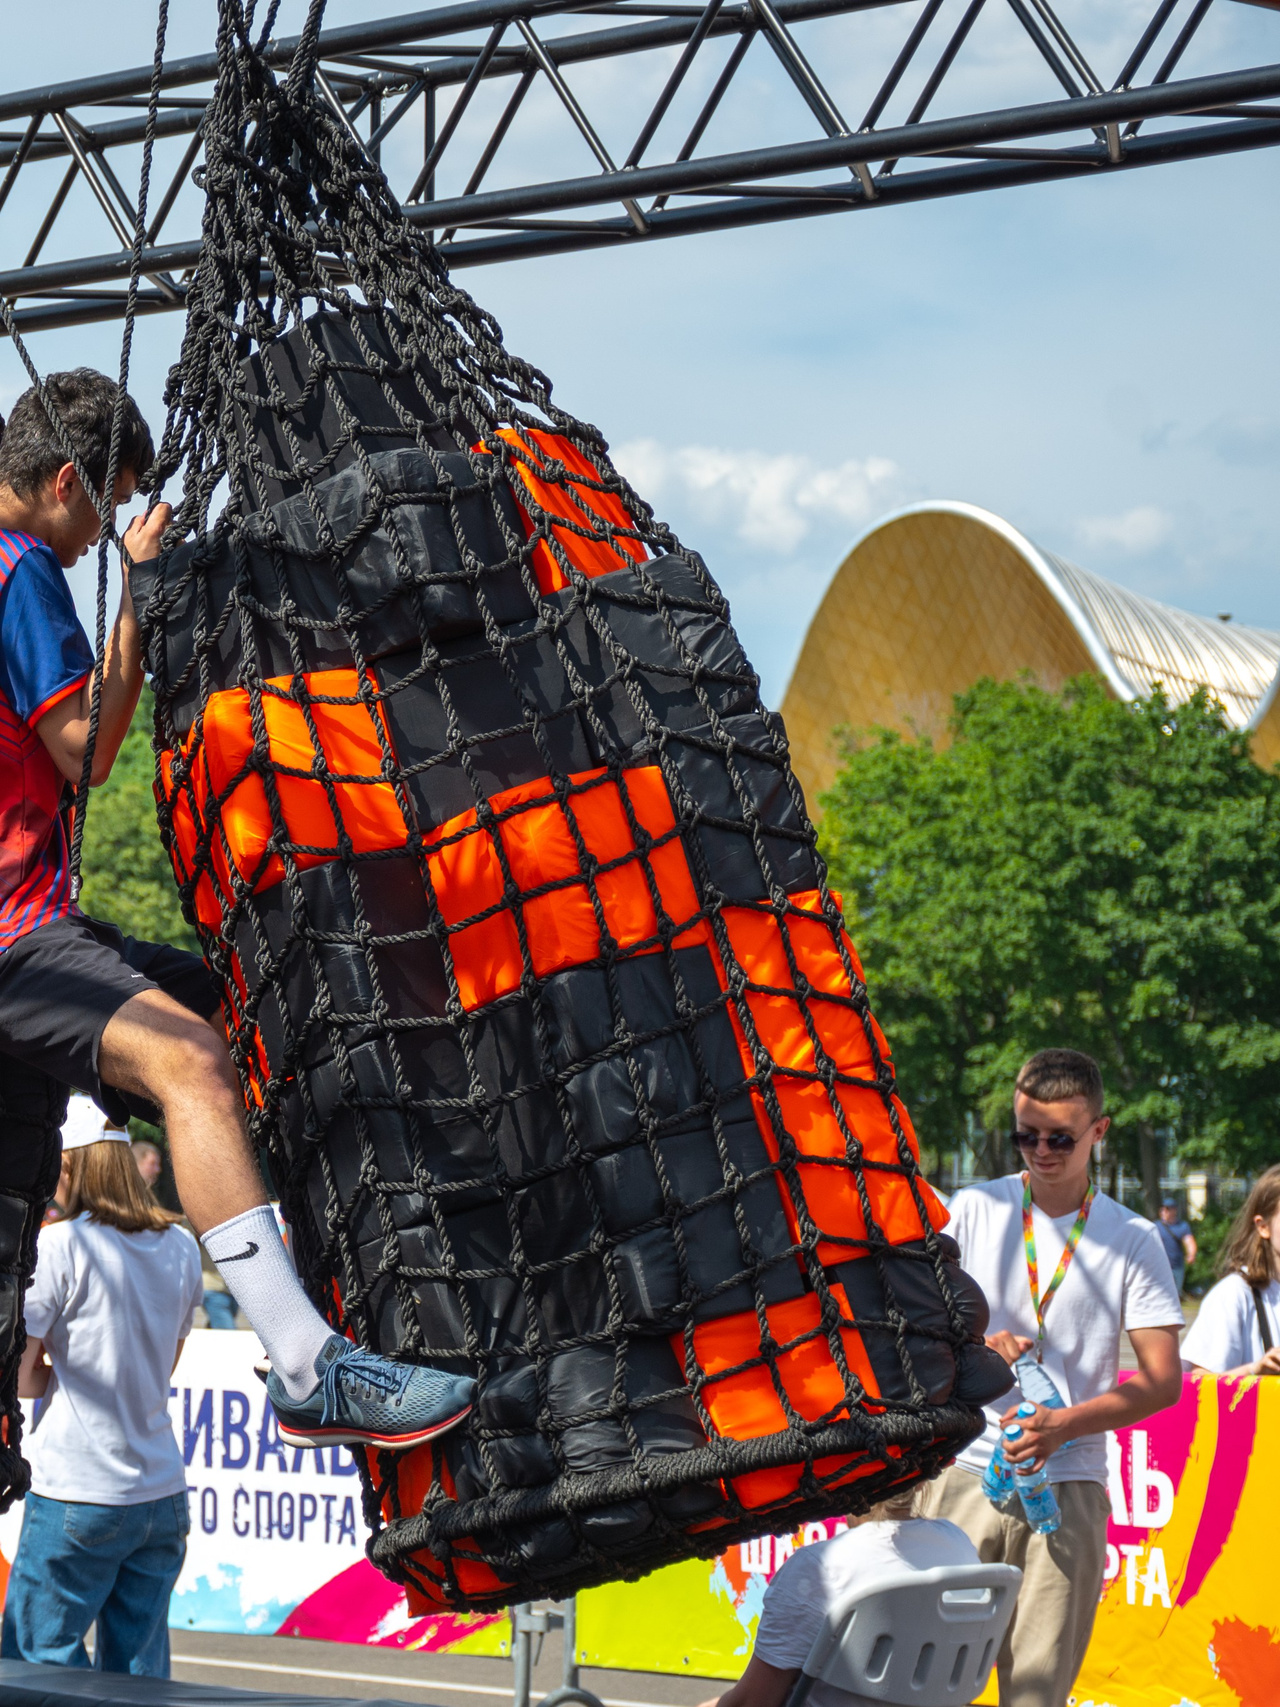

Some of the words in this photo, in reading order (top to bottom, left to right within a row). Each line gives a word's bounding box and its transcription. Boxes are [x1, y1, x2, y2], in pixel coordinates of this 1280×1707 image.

[170, 1387, 358, 1476] ИВА
[187, 1486, 218, 1535] О
[233, 1484, 357, 1547] СПОРТА
